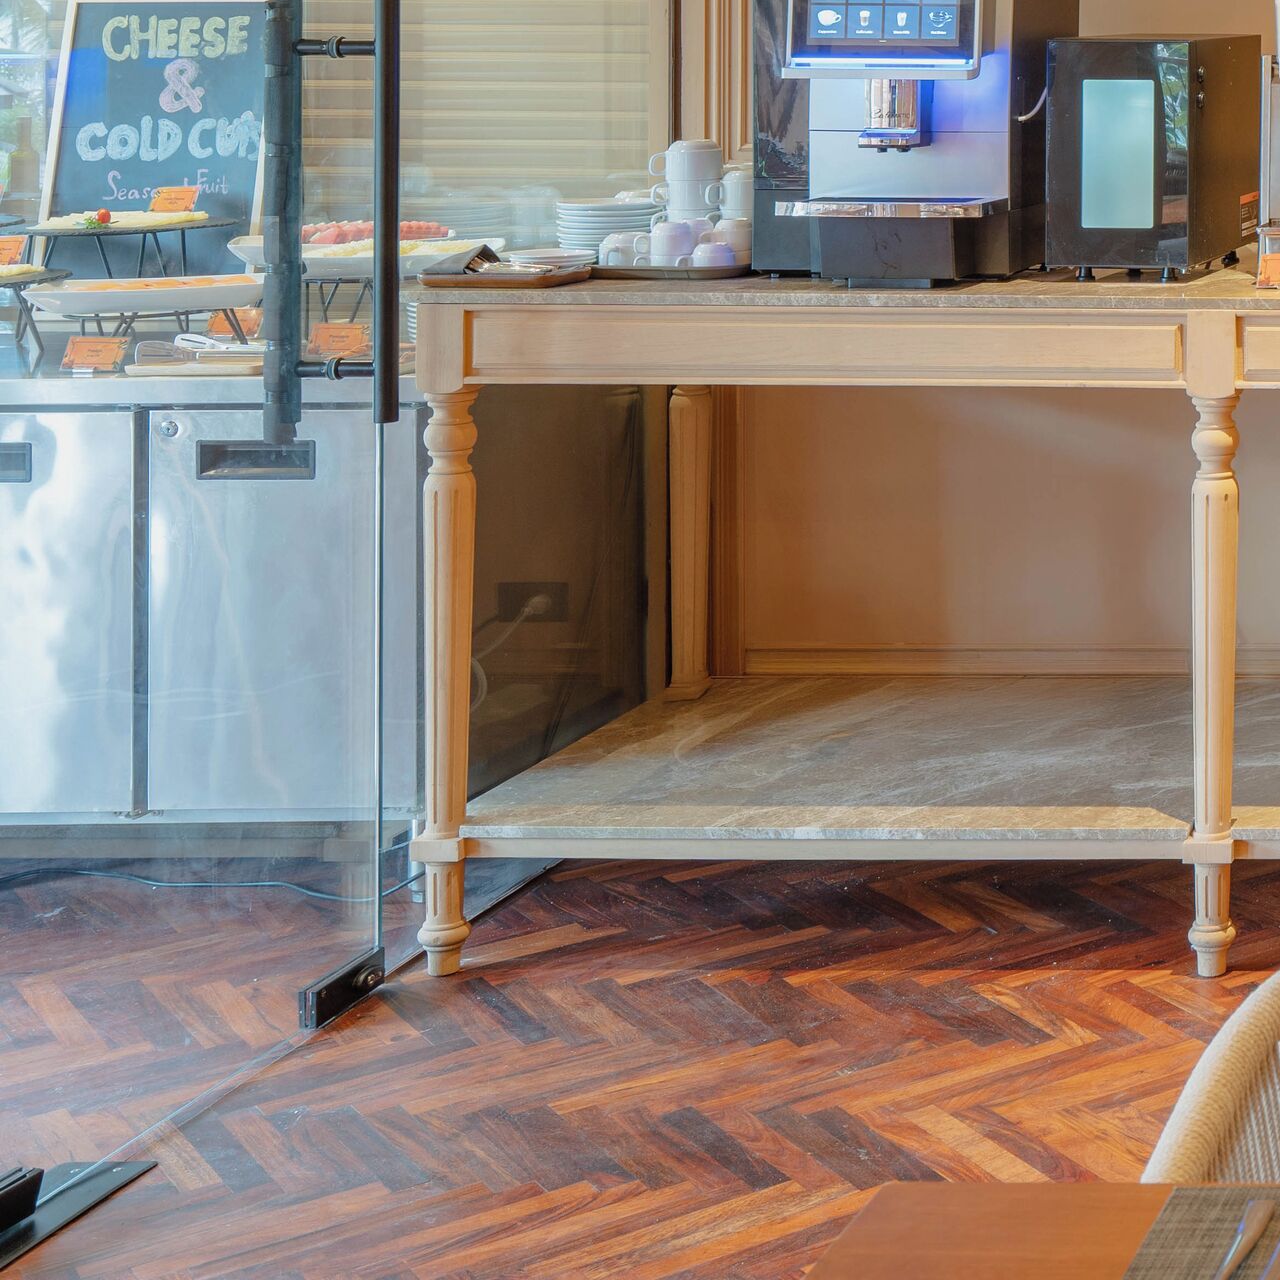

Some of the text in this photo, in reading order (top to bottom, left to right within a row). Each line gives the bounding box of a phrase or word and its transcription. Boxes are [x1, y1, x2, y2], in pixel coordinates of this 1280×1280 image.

[102, 15, 250, 61] CHEESE
[159, 58, 205, 113] &
[76, 111, 262, 162] COLD CUTS
[196, 169, 229, 195] Fruit
